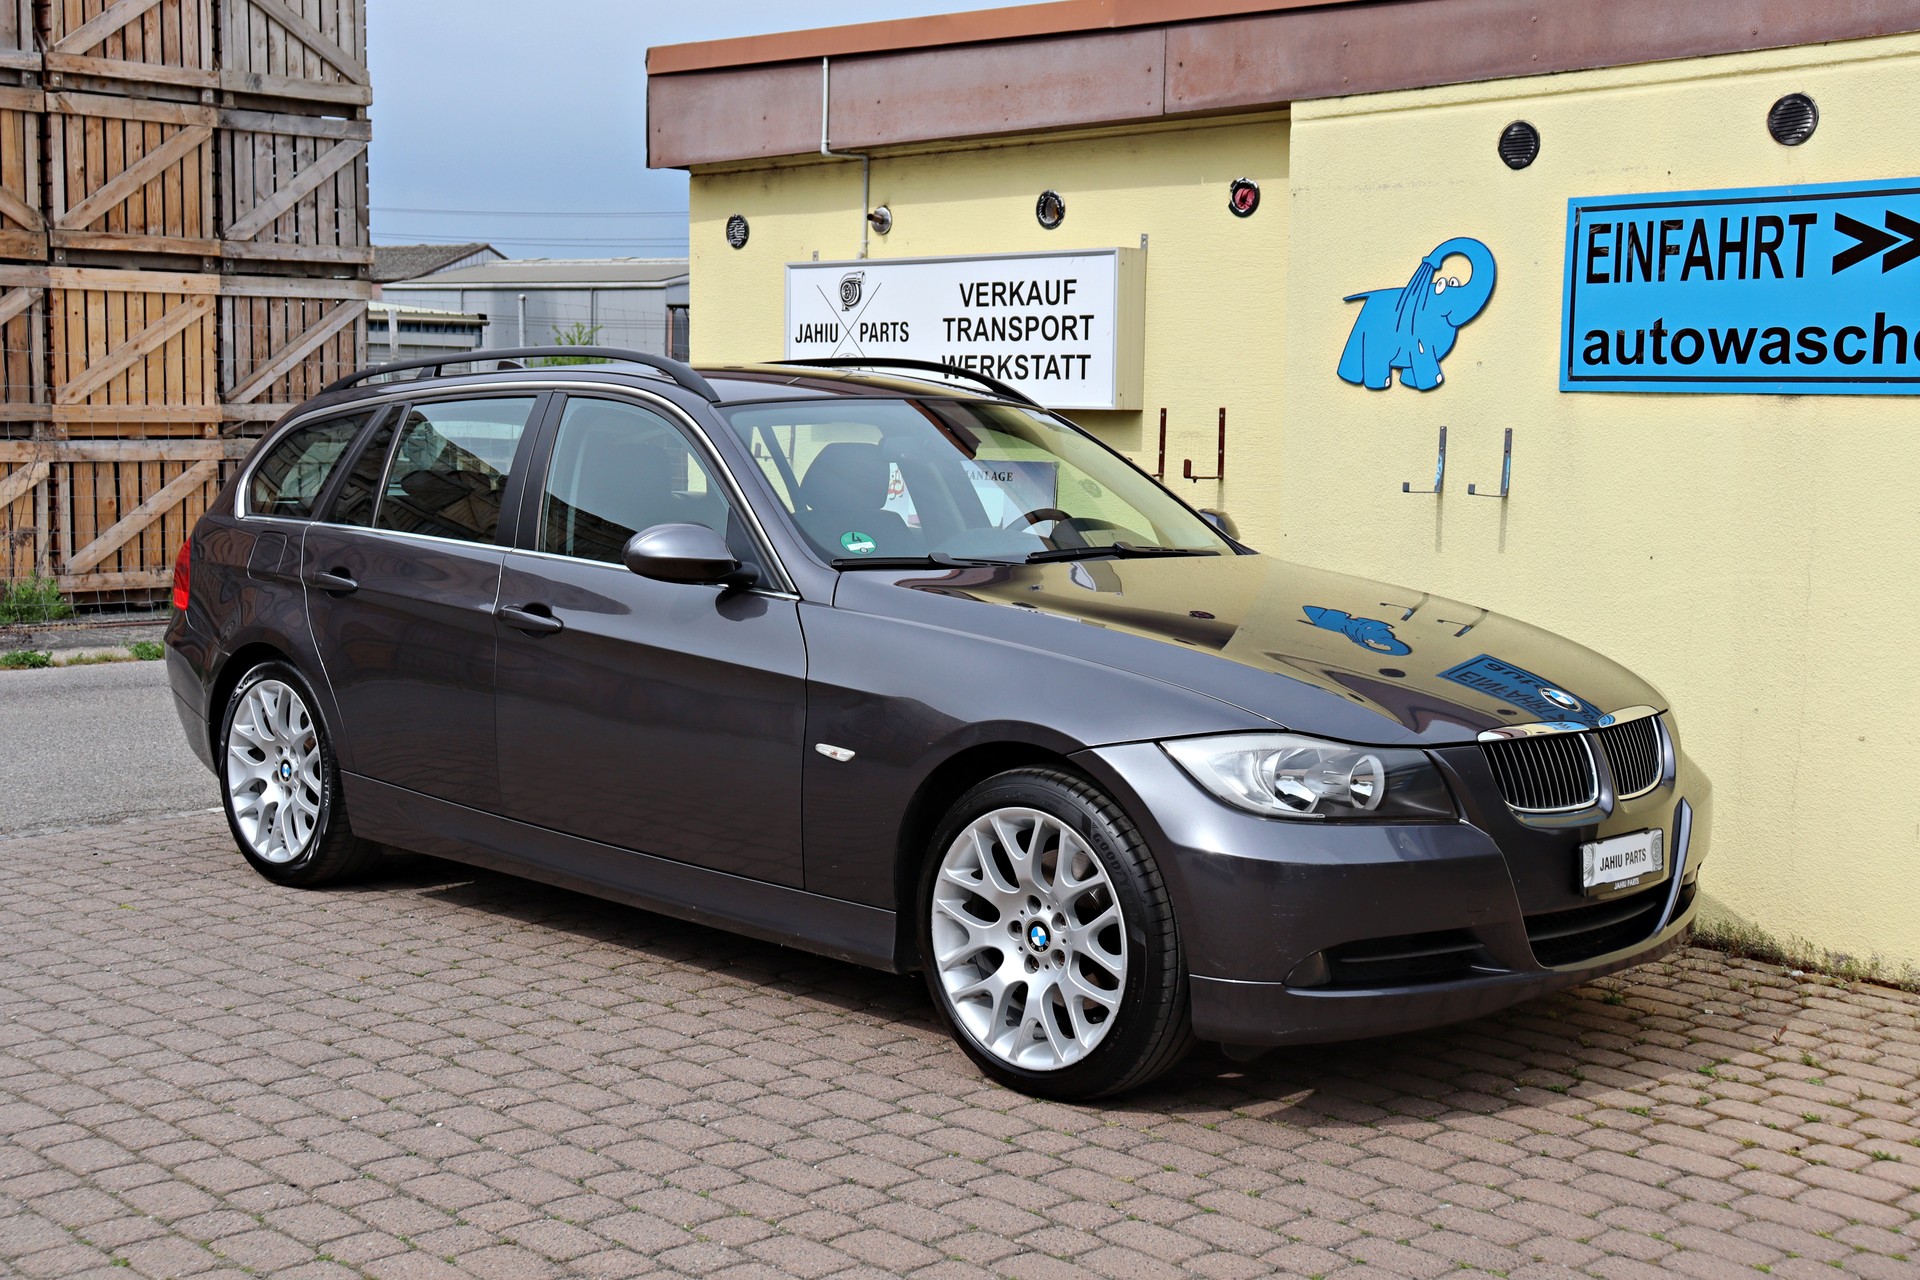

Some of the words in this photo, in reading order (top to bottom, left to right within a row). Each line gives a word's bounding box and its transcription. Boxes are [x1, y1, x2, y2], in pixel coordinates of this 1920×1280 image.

[1586, 213, 1818, 284] EINFAHRT
[959, 279, 1078, 308] VERKAUF
[795, 322, 839, 344] JAHIU
[859, 321, 910, 343] PARTS
[942, 314, 1095, 342] TRANSPORT
[1582, 312, 1920, 366] autowasch
[942, 354, 1092, 381] WERKSTATT
[966, 470, 1014, 482] ANLAGE
[1600, 854, 1622, 871] JAHIU
[1625, 848, 1646, 866] PARTS
